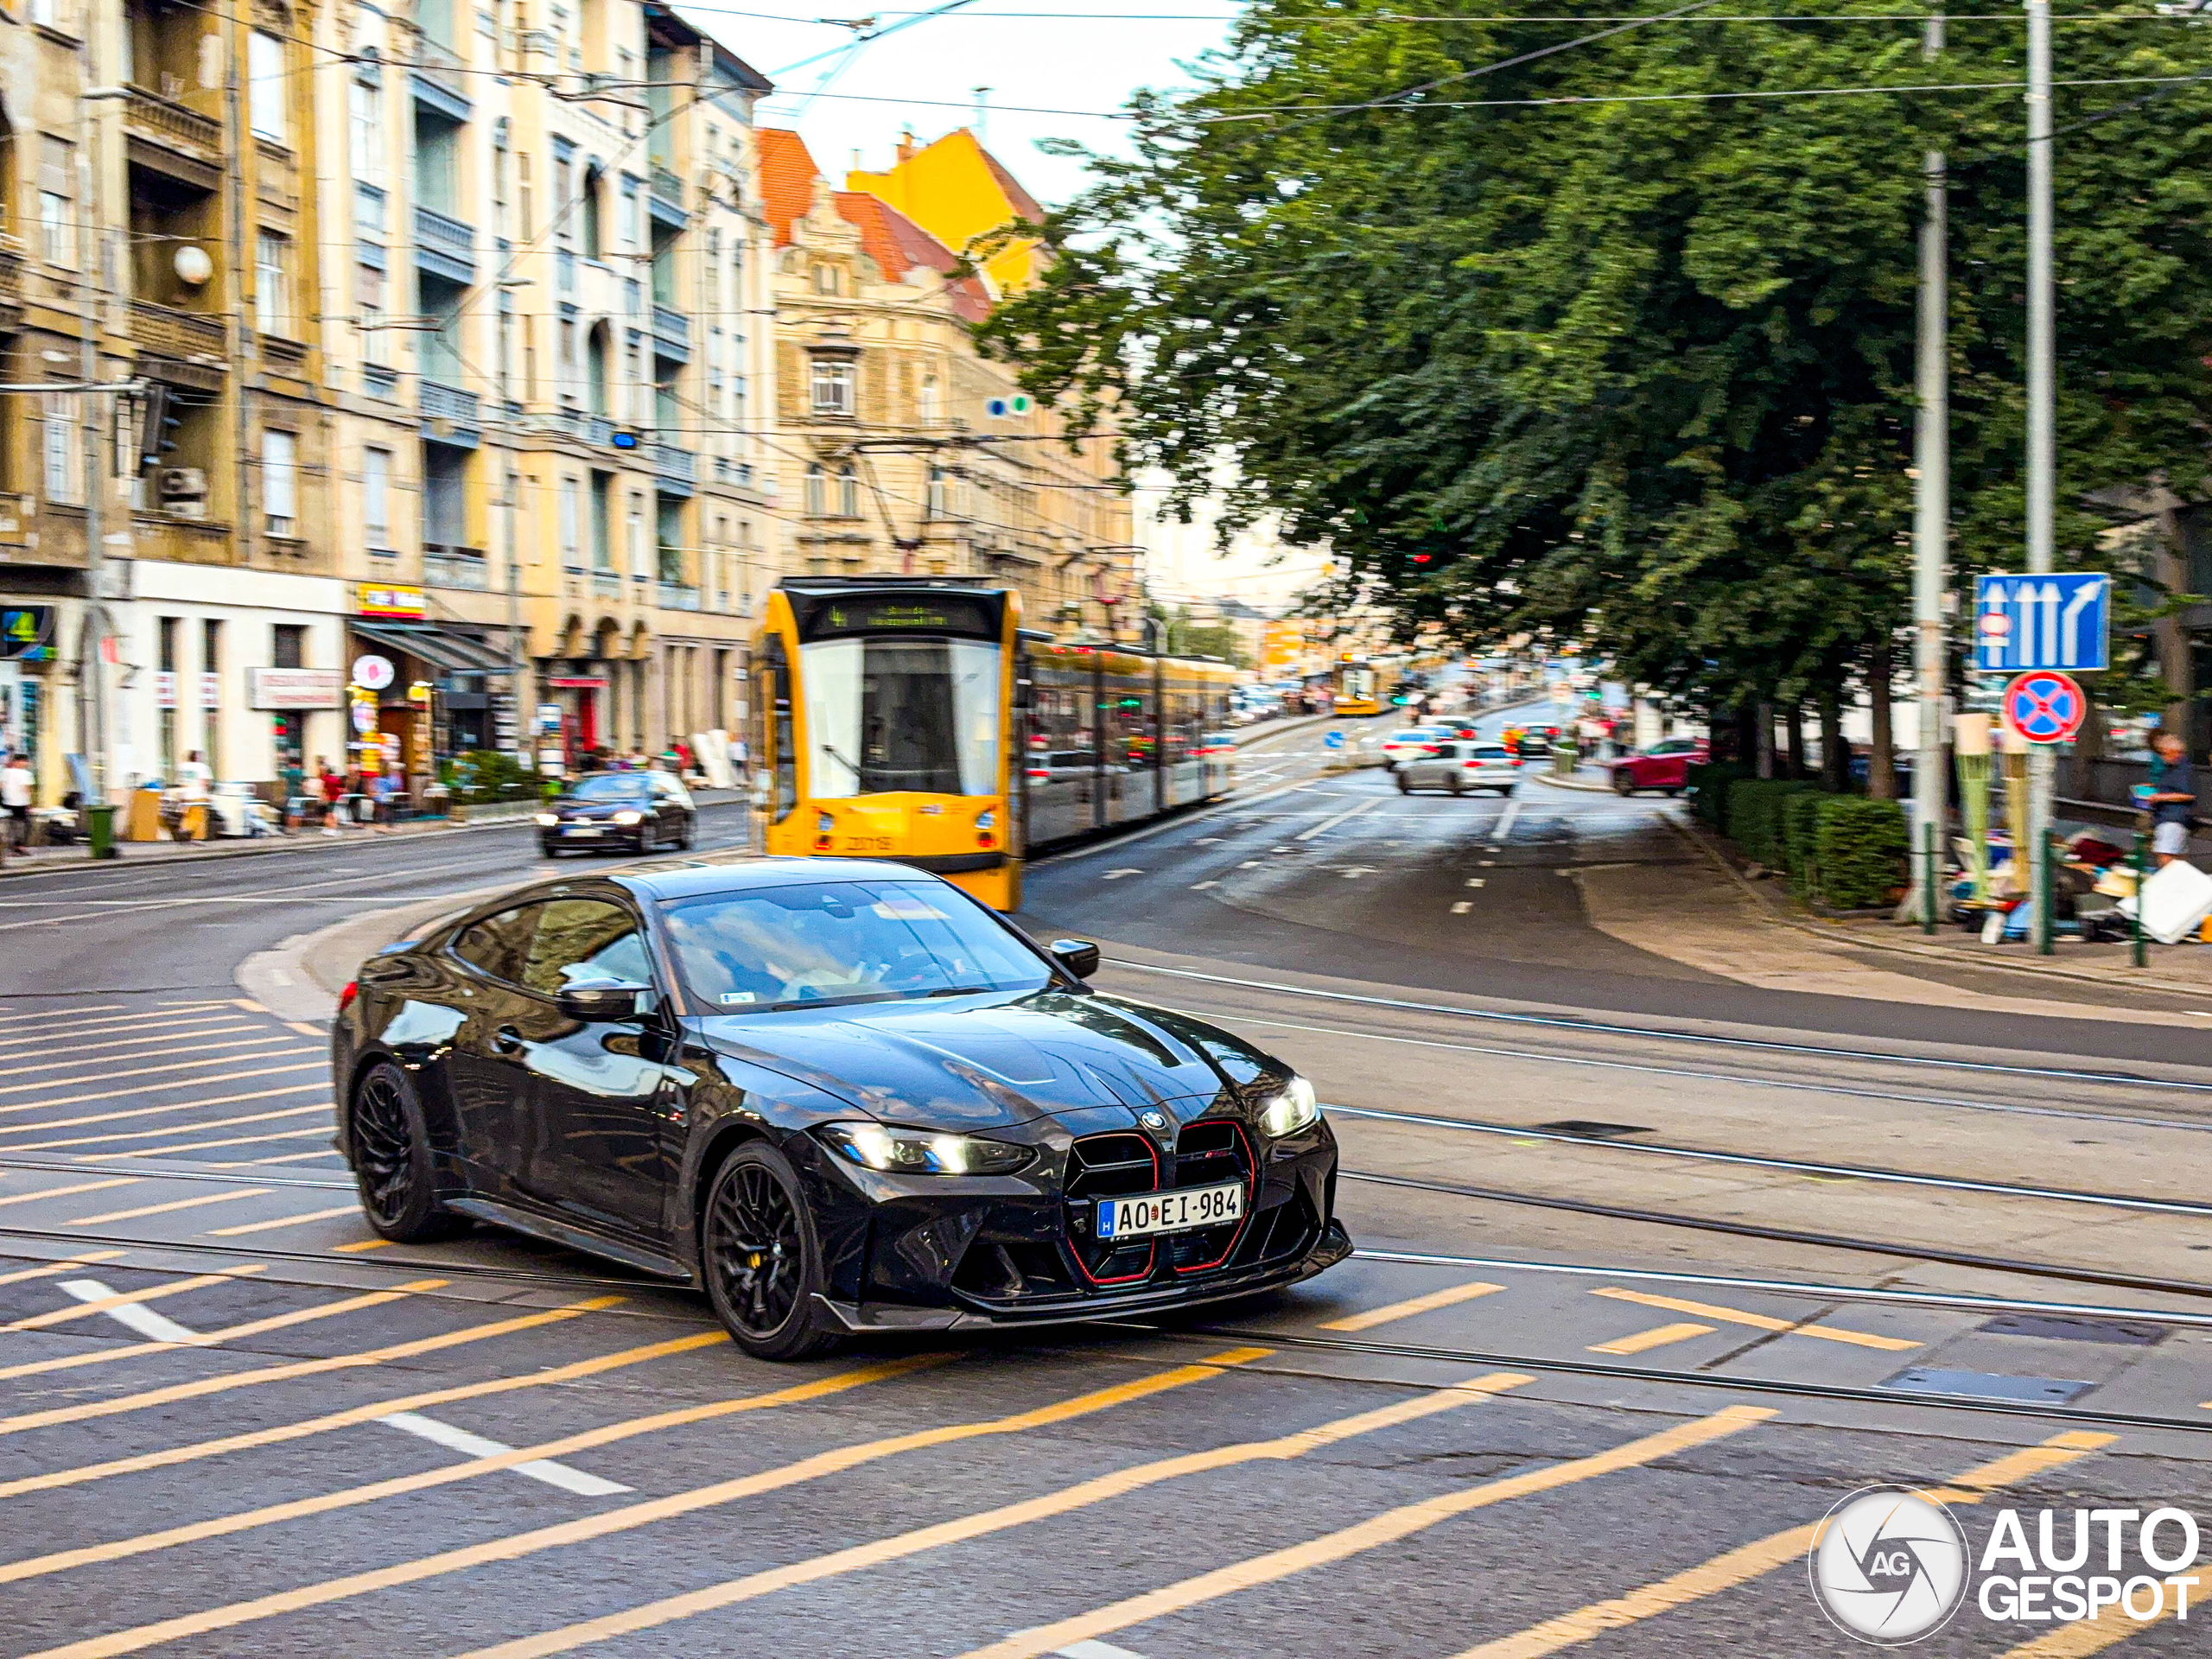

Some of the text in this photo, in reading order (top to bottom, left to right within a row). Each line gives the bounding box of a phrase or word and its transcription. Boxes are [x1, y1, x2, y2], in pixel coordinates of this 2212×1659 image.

[1119, 1189, 1236, 1230] AO EI-984
[1103, 1221, 1110, 1231] H
